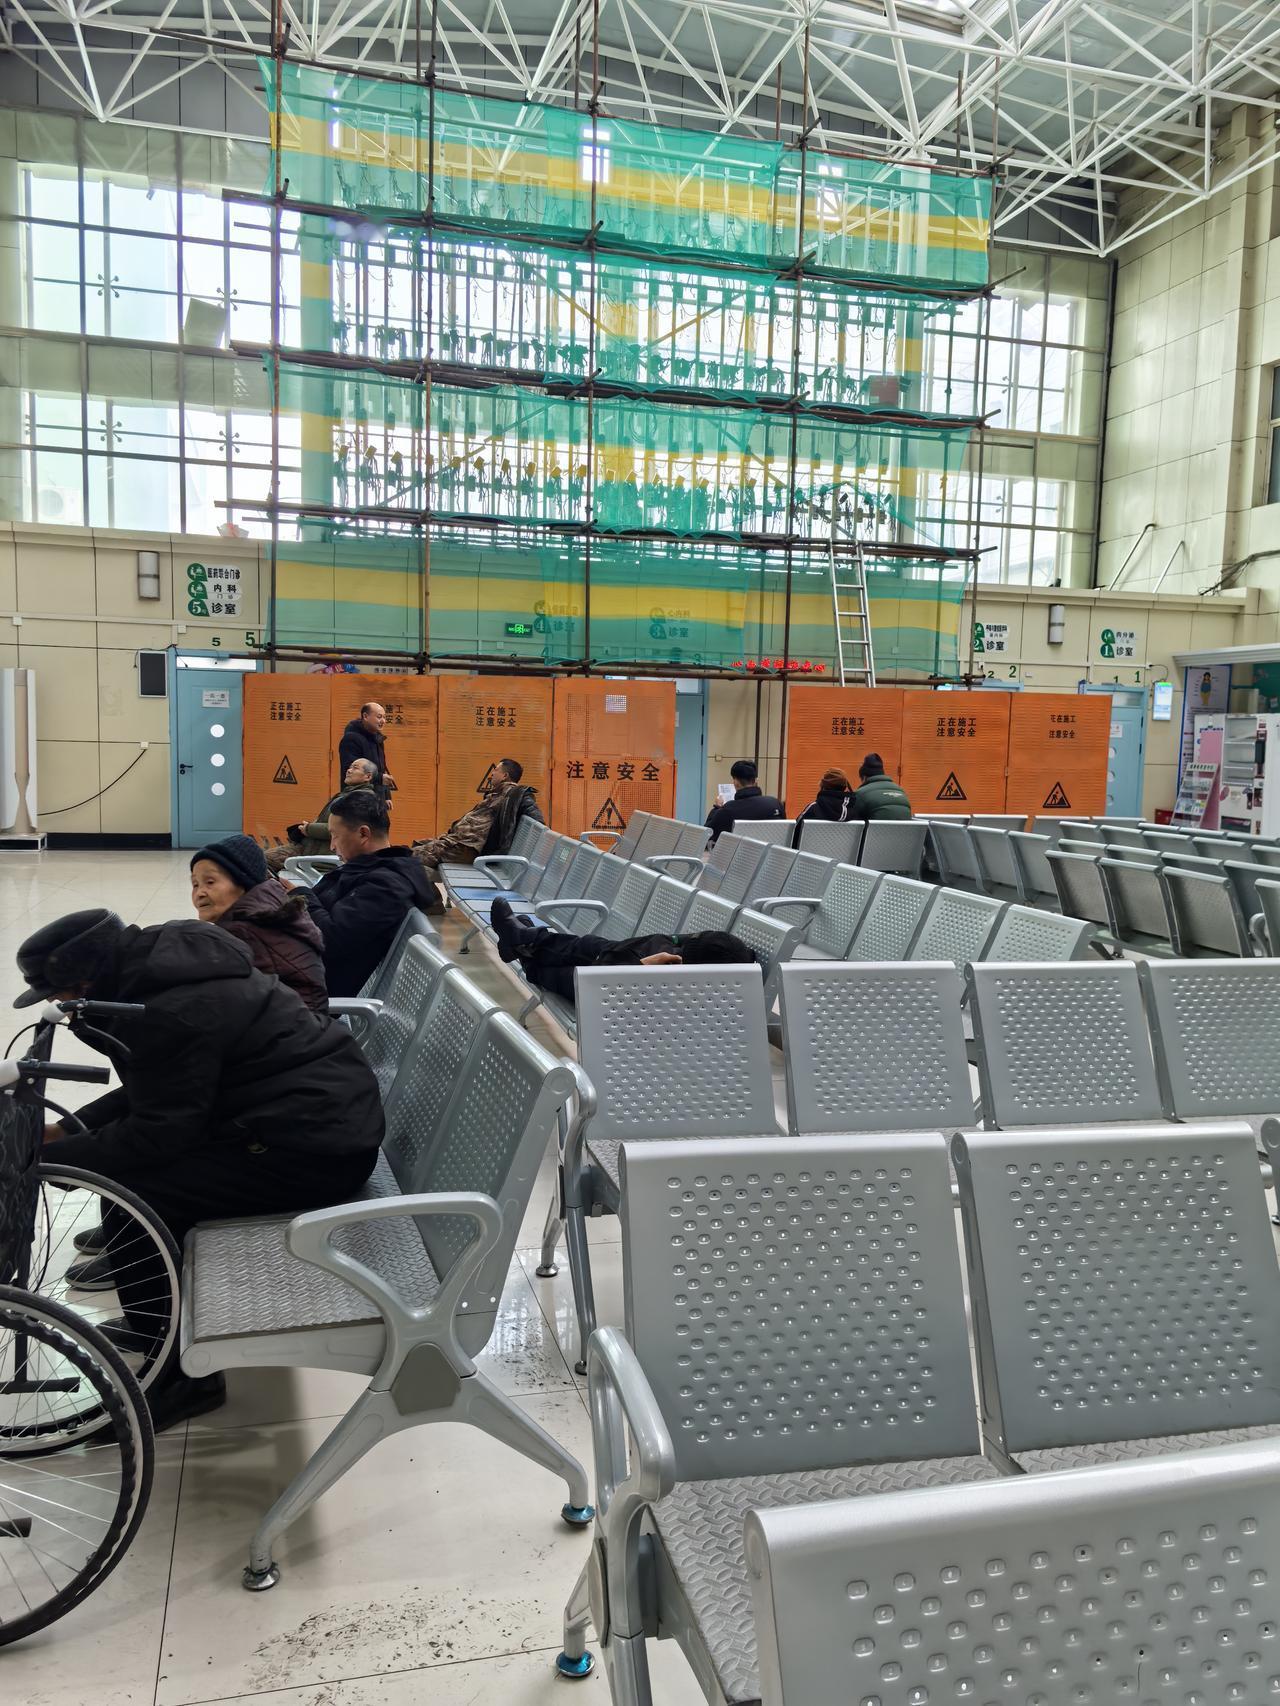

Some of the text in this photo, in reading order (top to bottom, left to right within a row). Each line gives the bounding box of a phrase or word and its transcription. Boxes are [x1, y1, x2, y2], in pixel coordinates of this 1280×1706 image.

[213, 584, 237, 593] 内科
[211, 602, 236, 615] 诊室
[211, 637, 221, 647] 5
[245, 631, 256, 647] 5
[986, 640, 1005, 651] 诊室
[1116, 646, 1133, 657] 诊室
[988, 670, 995, 679] 2
[1008, 665, 1017, 678] 2
[1134, 670, 1141, 683] 1
[270, 701, 302, 711] 正在施工
[475, 706, 517, 716] 正在施工
[270, 712, 302, 721] 注意安全
[831, 717, 865, 726] 正在施工
[475, 717, 517, 727] 注意安全
[937, 717, 976, 727] 正在施工
[831, 726, 865, 735] 注意安全
[937, 727, 976, 737] 注意安全
[566, 760, 660, 781] 注意安全
